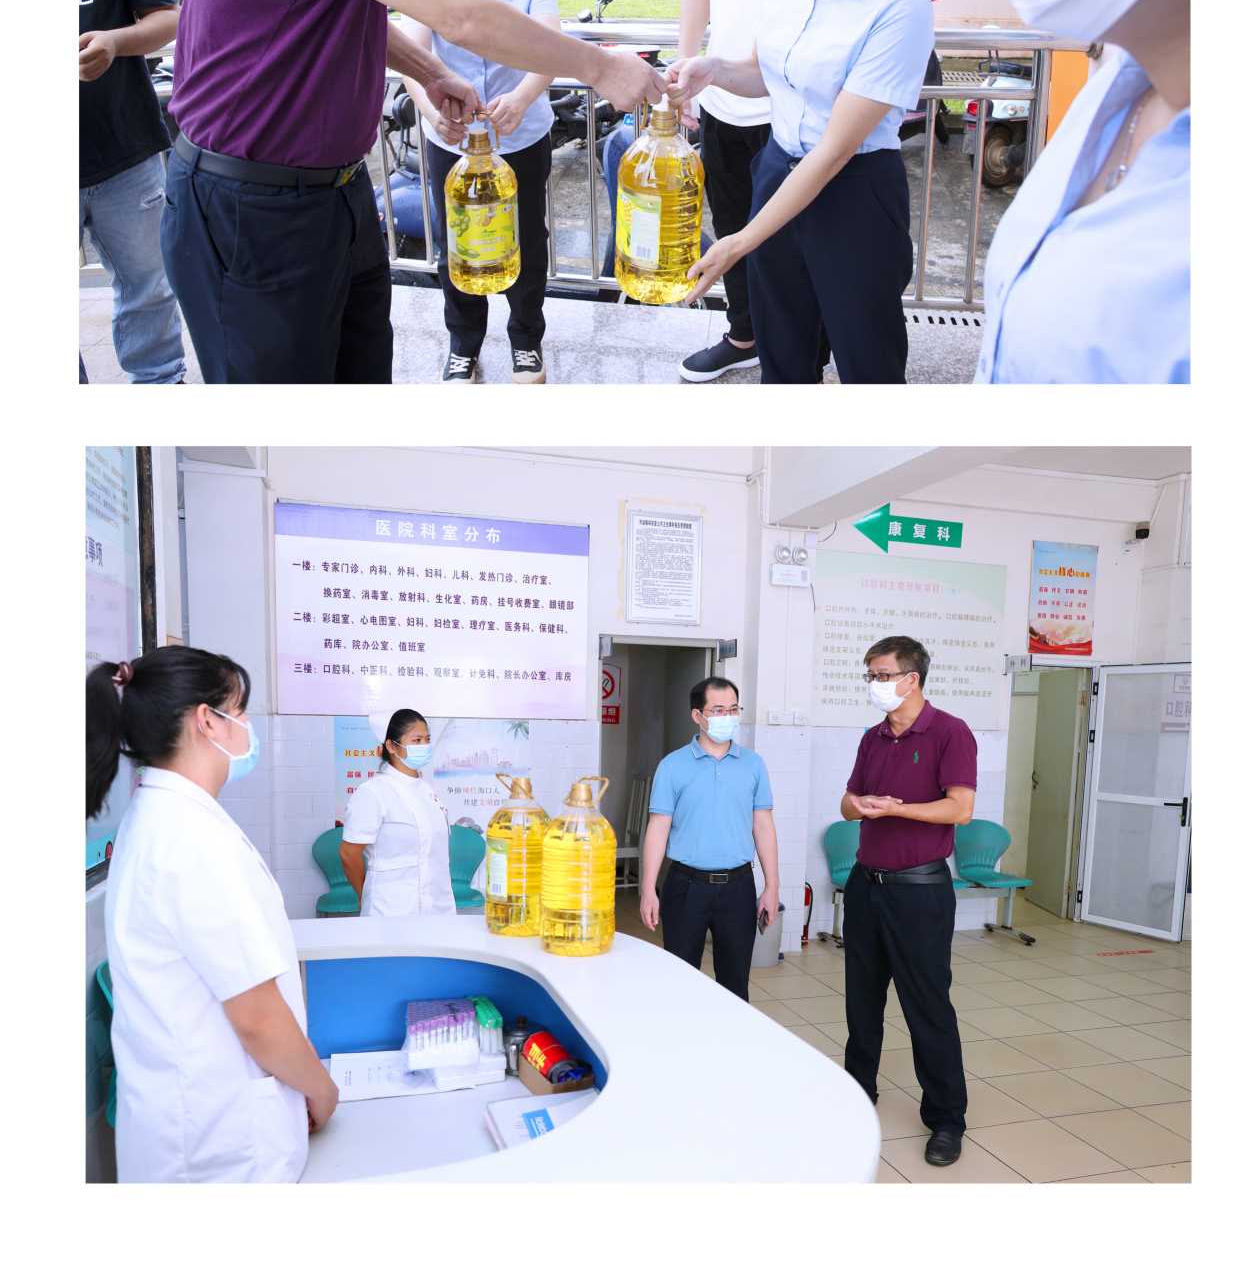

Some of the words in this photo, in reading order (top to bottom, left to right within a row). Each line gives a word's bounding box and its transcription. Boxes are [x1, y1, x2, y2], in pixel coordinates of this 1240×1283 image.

[375, 519, 501, 543] 医院科室分布
[888, 521, 951, 542] 康复科
